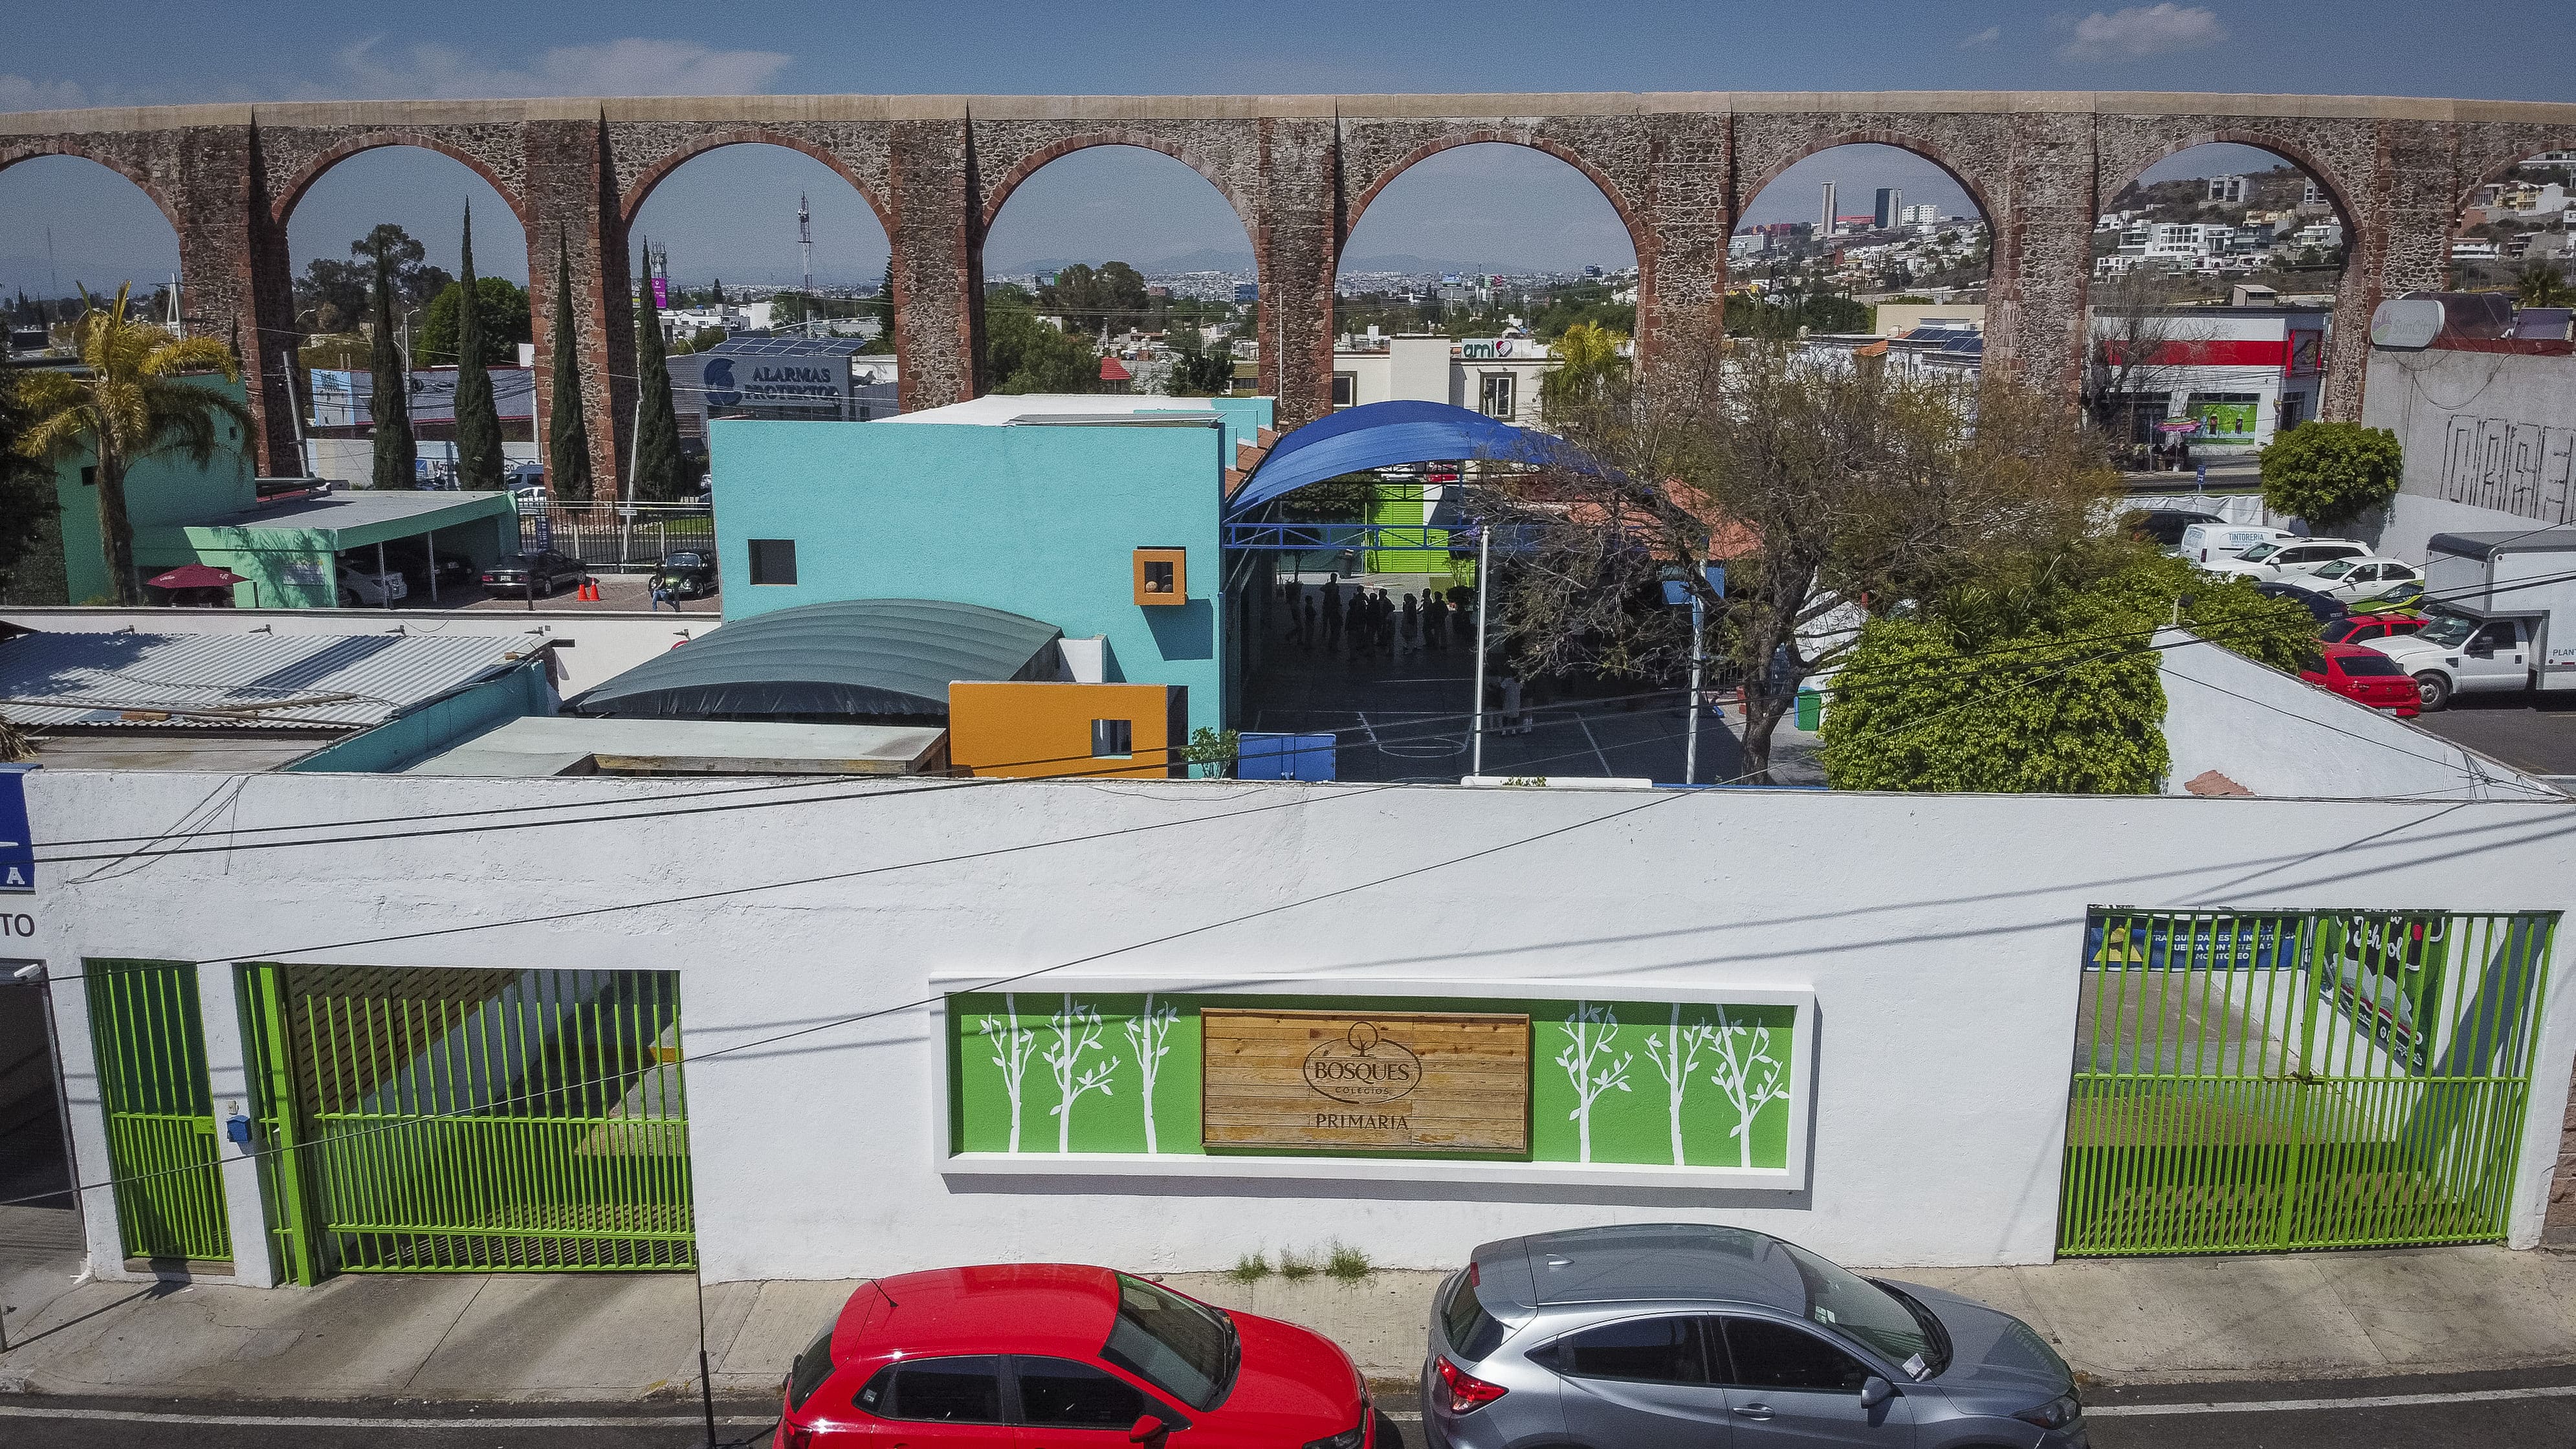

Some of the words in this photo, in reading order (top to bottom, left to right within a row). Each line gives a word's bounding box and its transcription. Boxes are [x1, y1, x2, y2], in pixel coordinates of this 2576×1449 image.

[1464, 340, 1495, 358] ami
[753, 366, 831, 383] ALARMAS
[1315, 1061, 1410, 1084] BOSQUES
[1335, 1087, 1389, 1095] COLEGIOS
[1316, 1113, 1409, 1131] PRIMARIA
